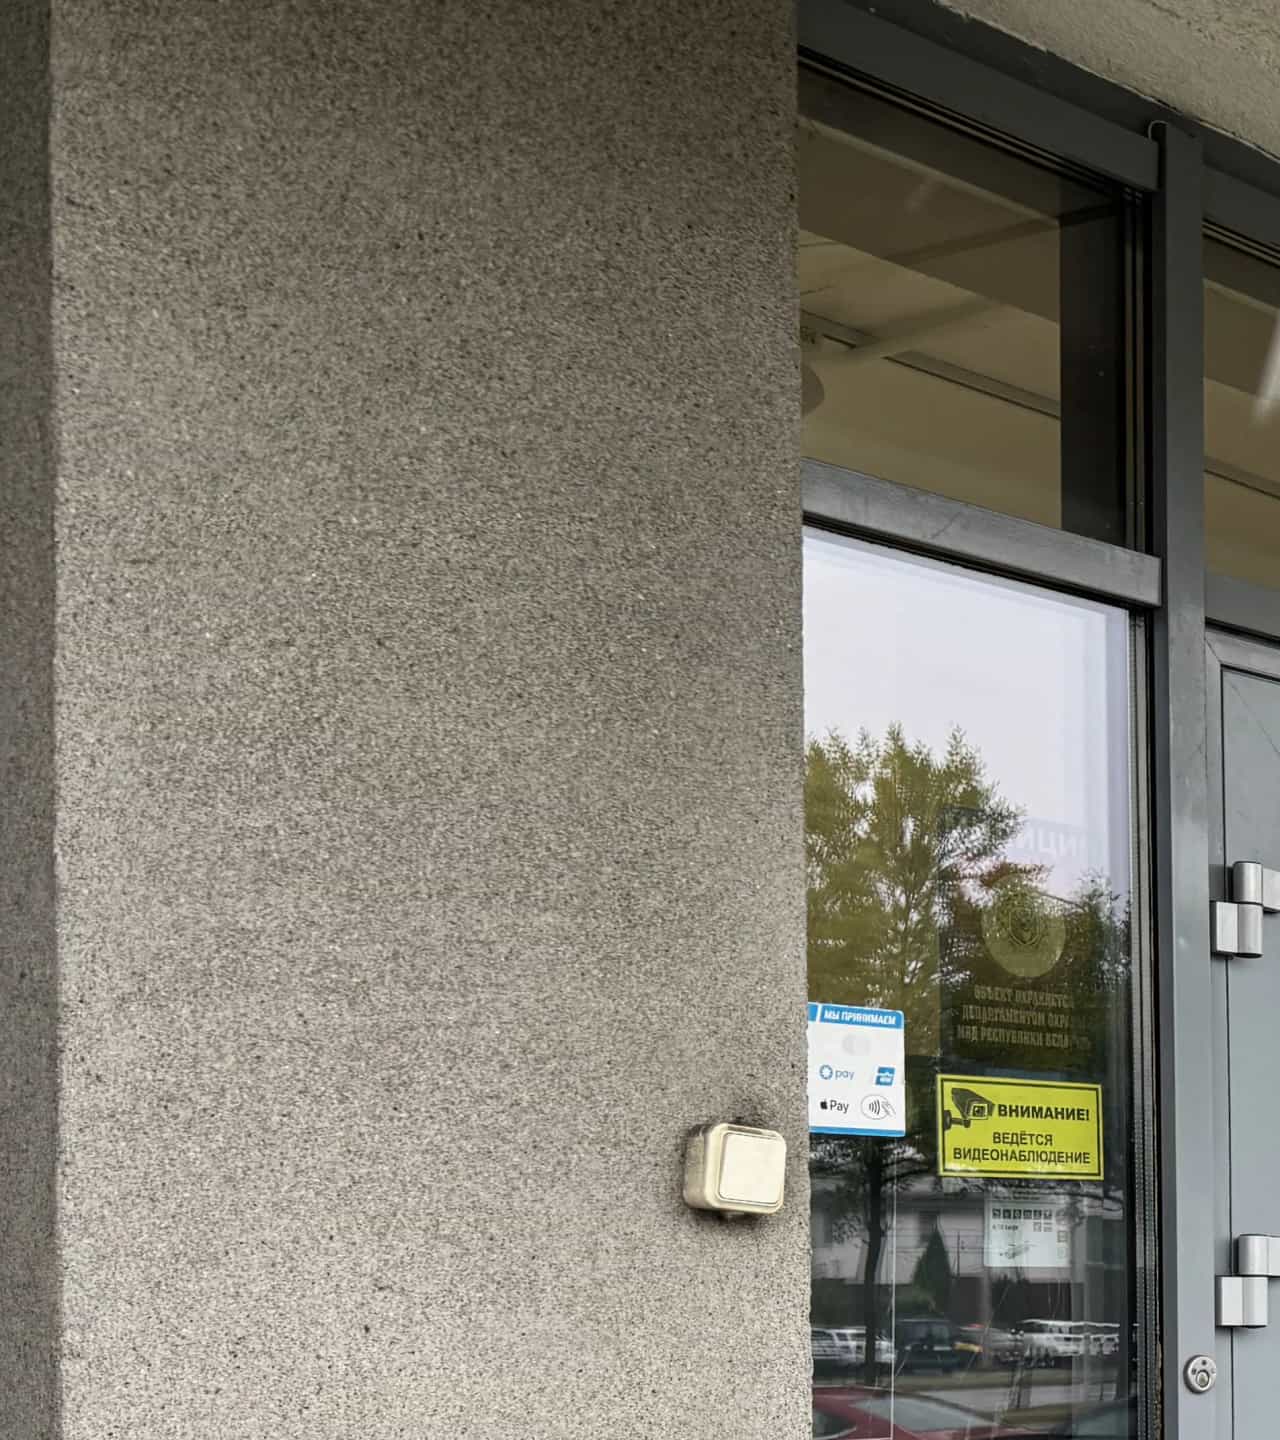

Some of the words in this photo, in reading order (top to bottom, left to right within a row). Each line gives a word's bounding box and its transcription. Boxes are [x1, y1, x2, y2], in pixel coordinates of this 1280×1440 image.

[1015, 989, 1074, 1008] ОХРАНЯЕТС
[824, 1009, 840, 1020] МЫ
[841, 1011, 896, 1025] ПРИНИМАЕМ
[835, 1069, 854, 1080] pay
[830, 1099, 849, 1114] Pay
[998, 1104, 1090, 1121] ВНИМАНИЕ!
[992, 1131, 1053, 1147] ВЕДЁТСЯ
[953, 1148, 1090, 1165] ВИДЕОНАБЛЮДЕНИЕ
